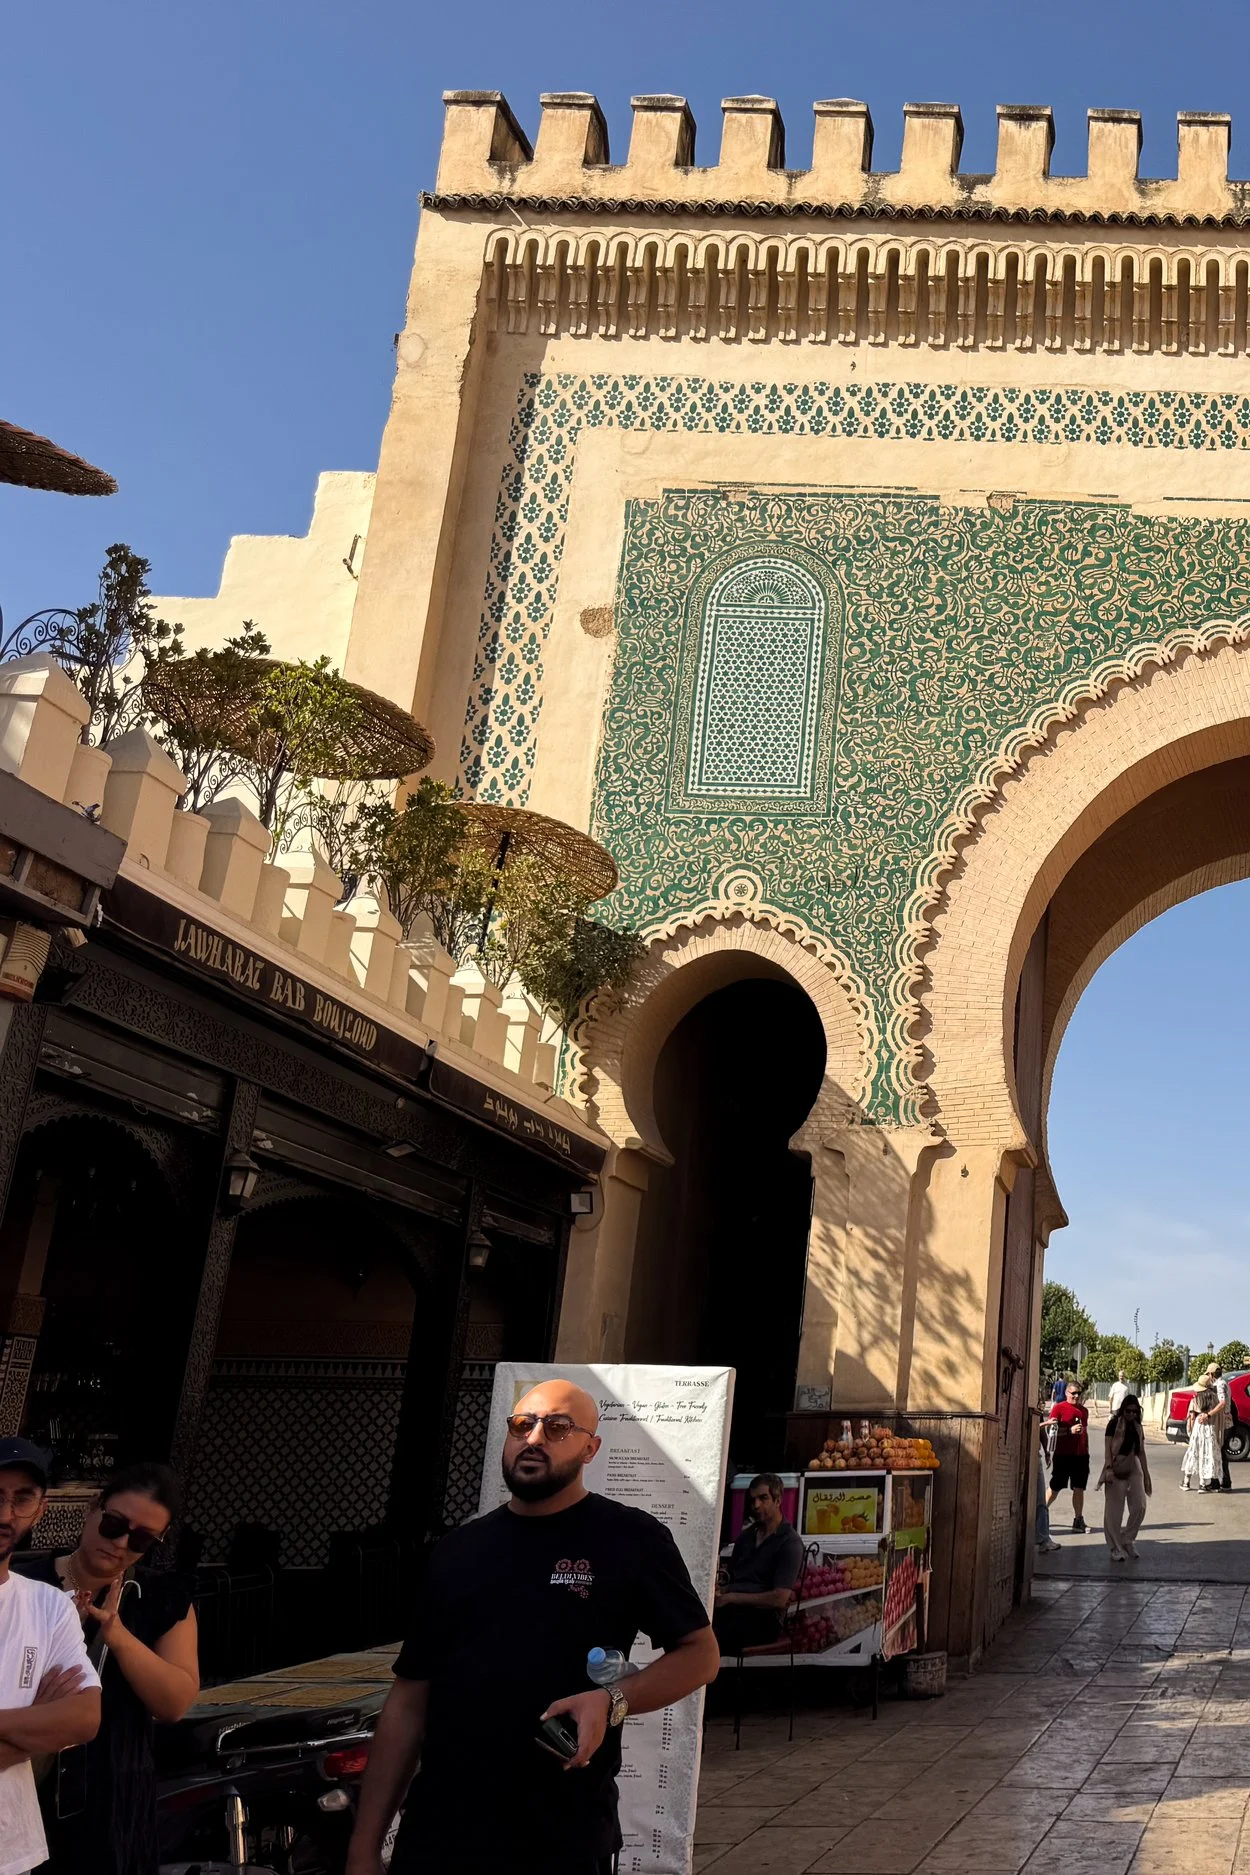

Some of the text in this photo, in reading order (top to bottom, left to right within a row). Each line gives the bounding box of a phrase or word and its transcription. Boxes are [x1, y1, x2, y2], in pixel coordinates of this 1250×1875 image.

[174, 919, 378, 1050] JAWHARAT BAB BOUJLOUD
[674, 1380, 710, 1388] TERRASSE
[812, 1491, 845, 1503] البرتقال
